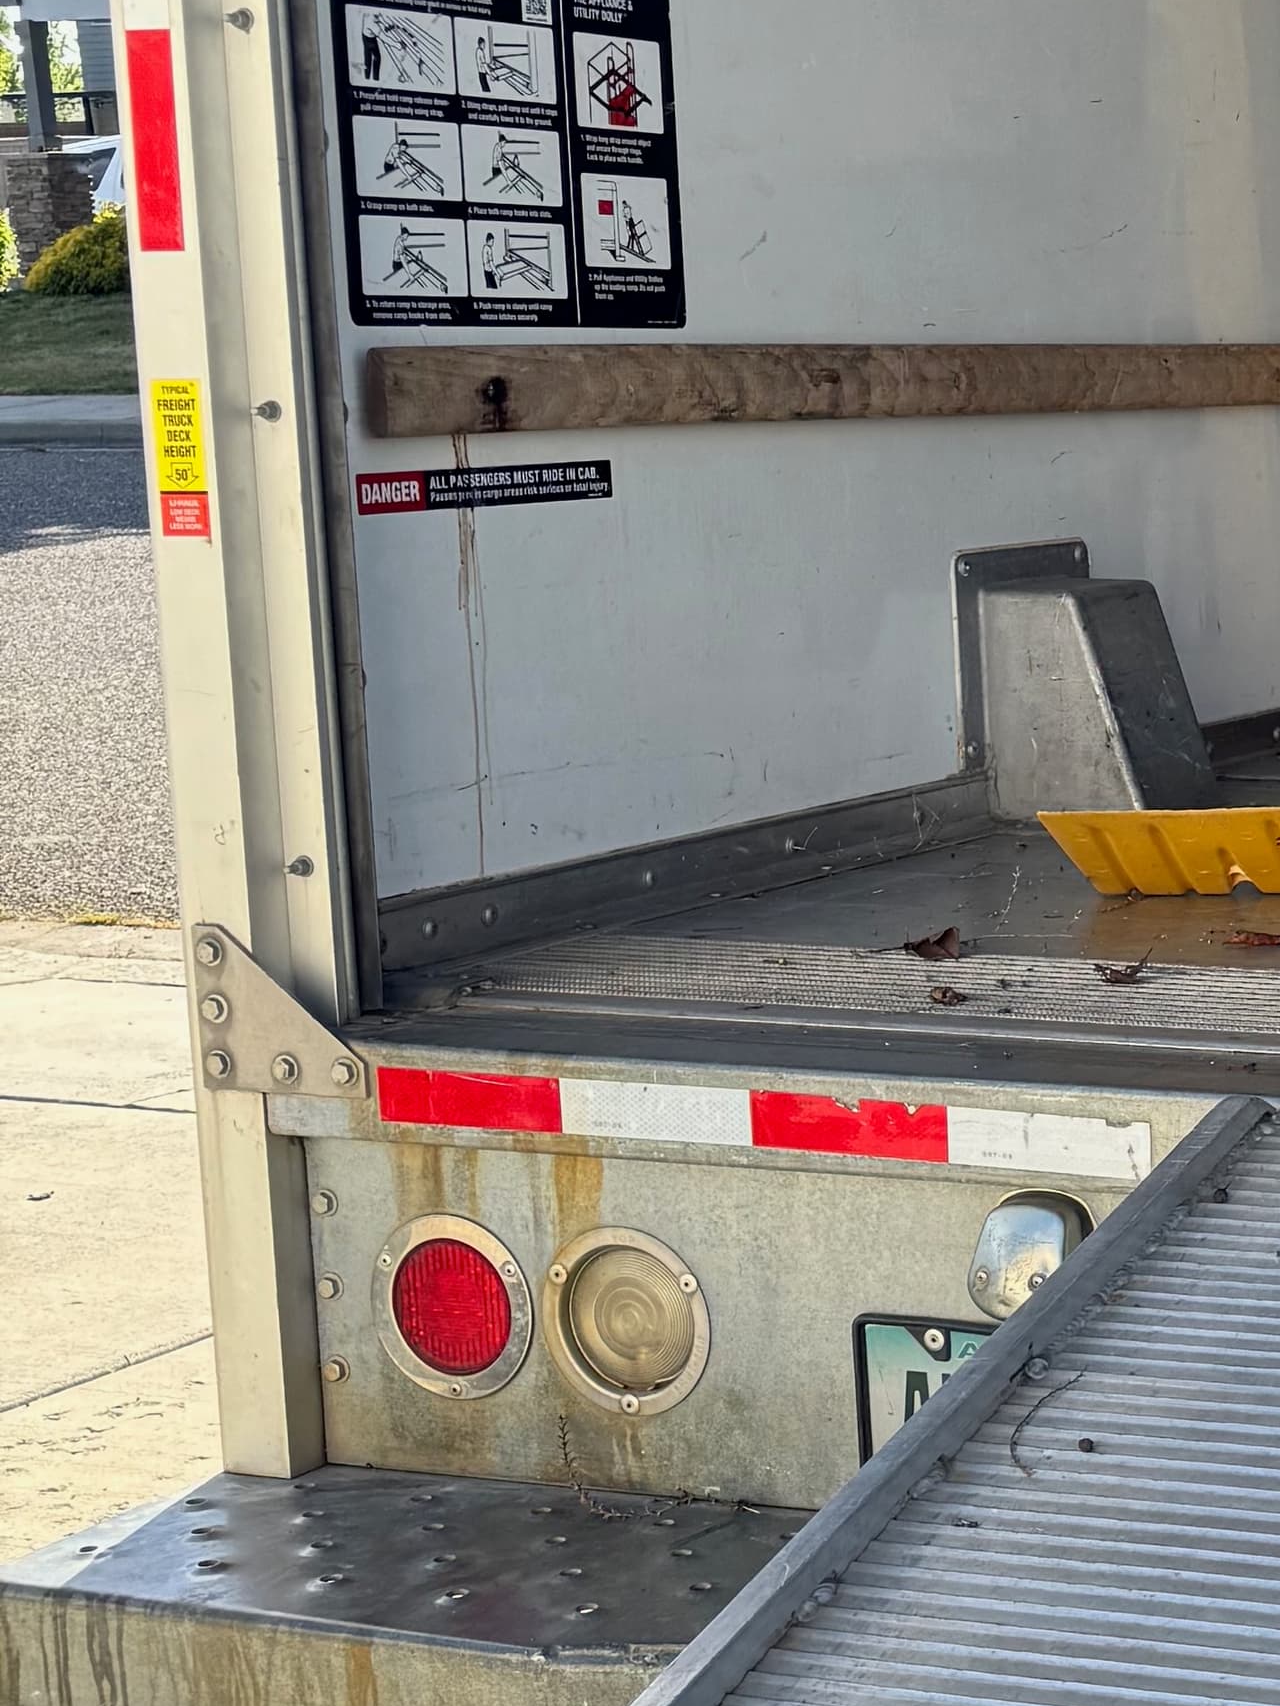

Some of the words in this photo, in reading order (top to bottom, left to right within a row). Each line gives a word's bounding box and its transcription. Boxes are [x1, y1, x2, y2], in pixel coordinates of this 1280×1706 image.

[573, 6, 600, 21] UTILITY
[601, 10, 622, 23] DOLLY
[161, 386, 189, 394] TYPICAL
[157, 399, 195, 411] FREIGHT
[163, 415, 193, 427] TRUCK
[167, 430, 191, 442] DECK
[164, 446, 196, 458] HEIGHT
[429, 475, 449, 490] ALL
[450, 471, 512, 488] PASSENGERS
[513, 469, 540, 483] MUST
[543, 467, 565, 481] RIDE
[566, 467, 576, 480] IN
[361, 480, 420, 504] DANGER
